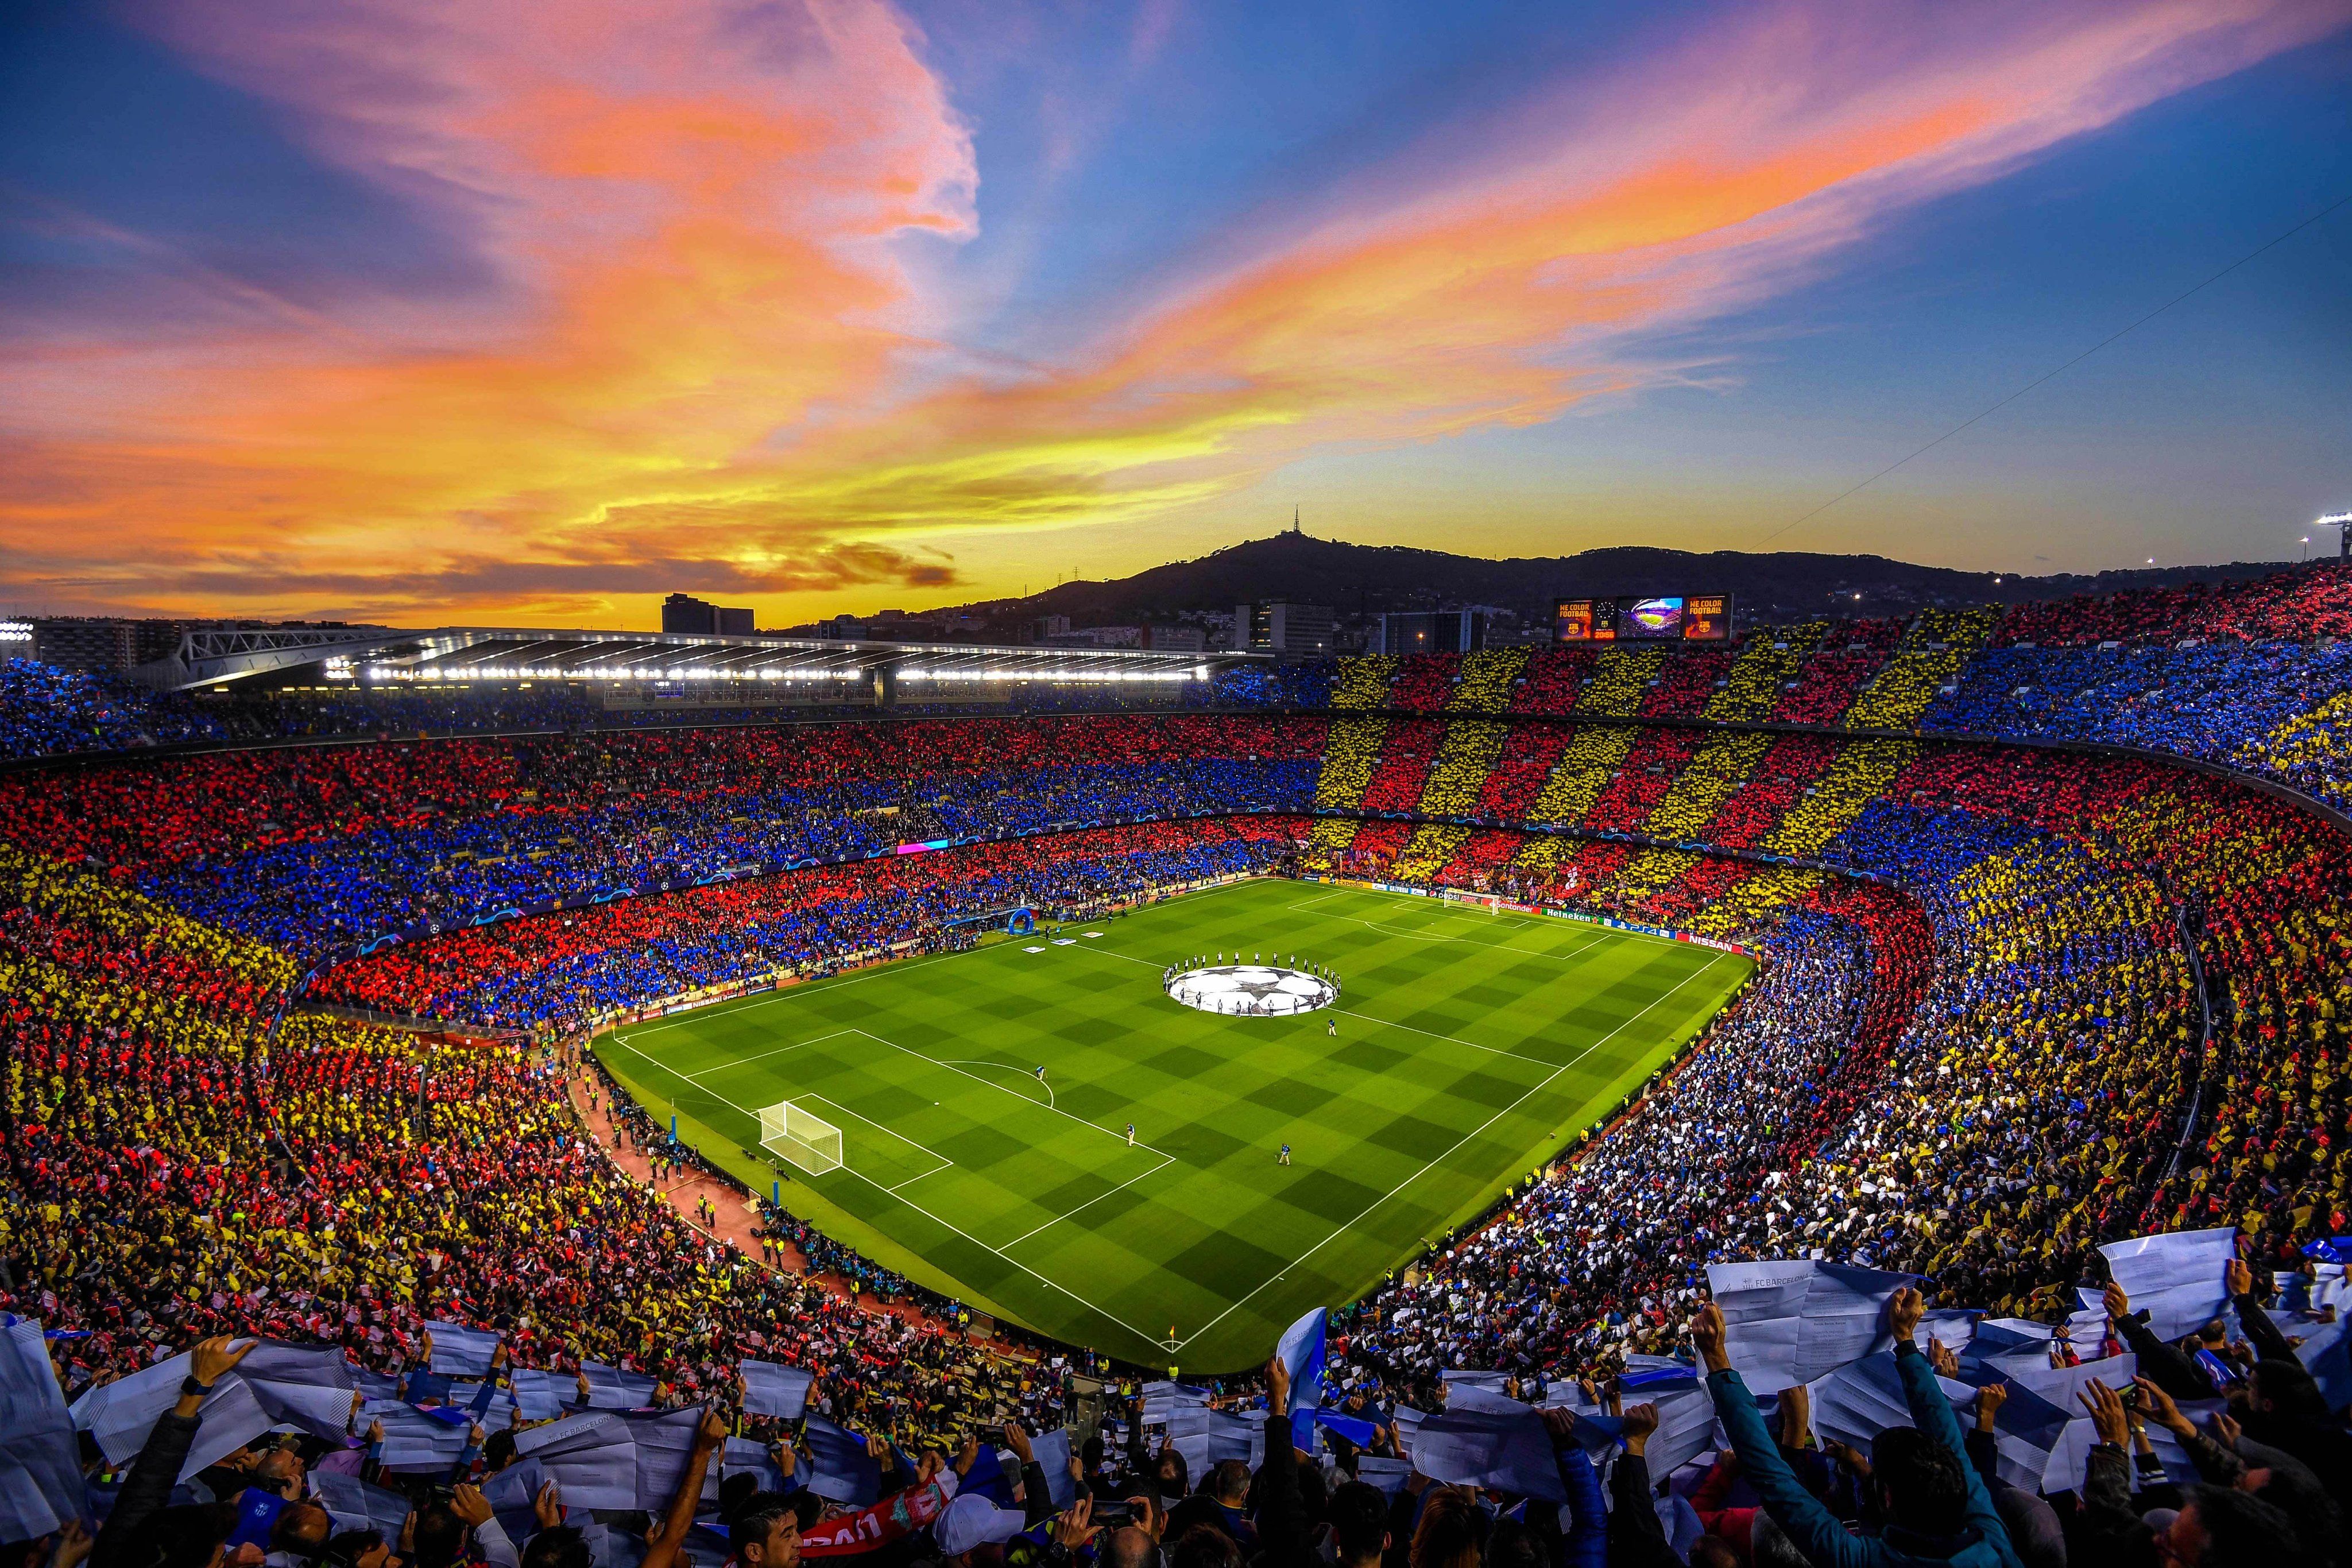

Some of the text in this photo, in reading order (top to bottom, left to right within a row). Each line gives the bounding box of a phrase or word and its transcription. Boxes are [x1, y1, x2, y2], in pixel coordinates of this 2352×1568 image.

[1689, 607, 1722, 615] FOOTBALL
[1338, 879, 1363, 888] Expedia
[1389, 885, 1409, 893] GAZPROM
[1438, 892, 1459, 901] pepsi
[1496, 901, 1533, 913] Santander
[1547, 908, 1591, 922] Heineken
[1630, 924, 1658, 935] PS4
[1689, 935, 1732, 952] NISSAN
[693, 997, 720, 1008] NISSAN
[1755, 1273, 1808, 1287] FC BARCELONA
[560, 1414, 615, 1439] FC BARCELONA
